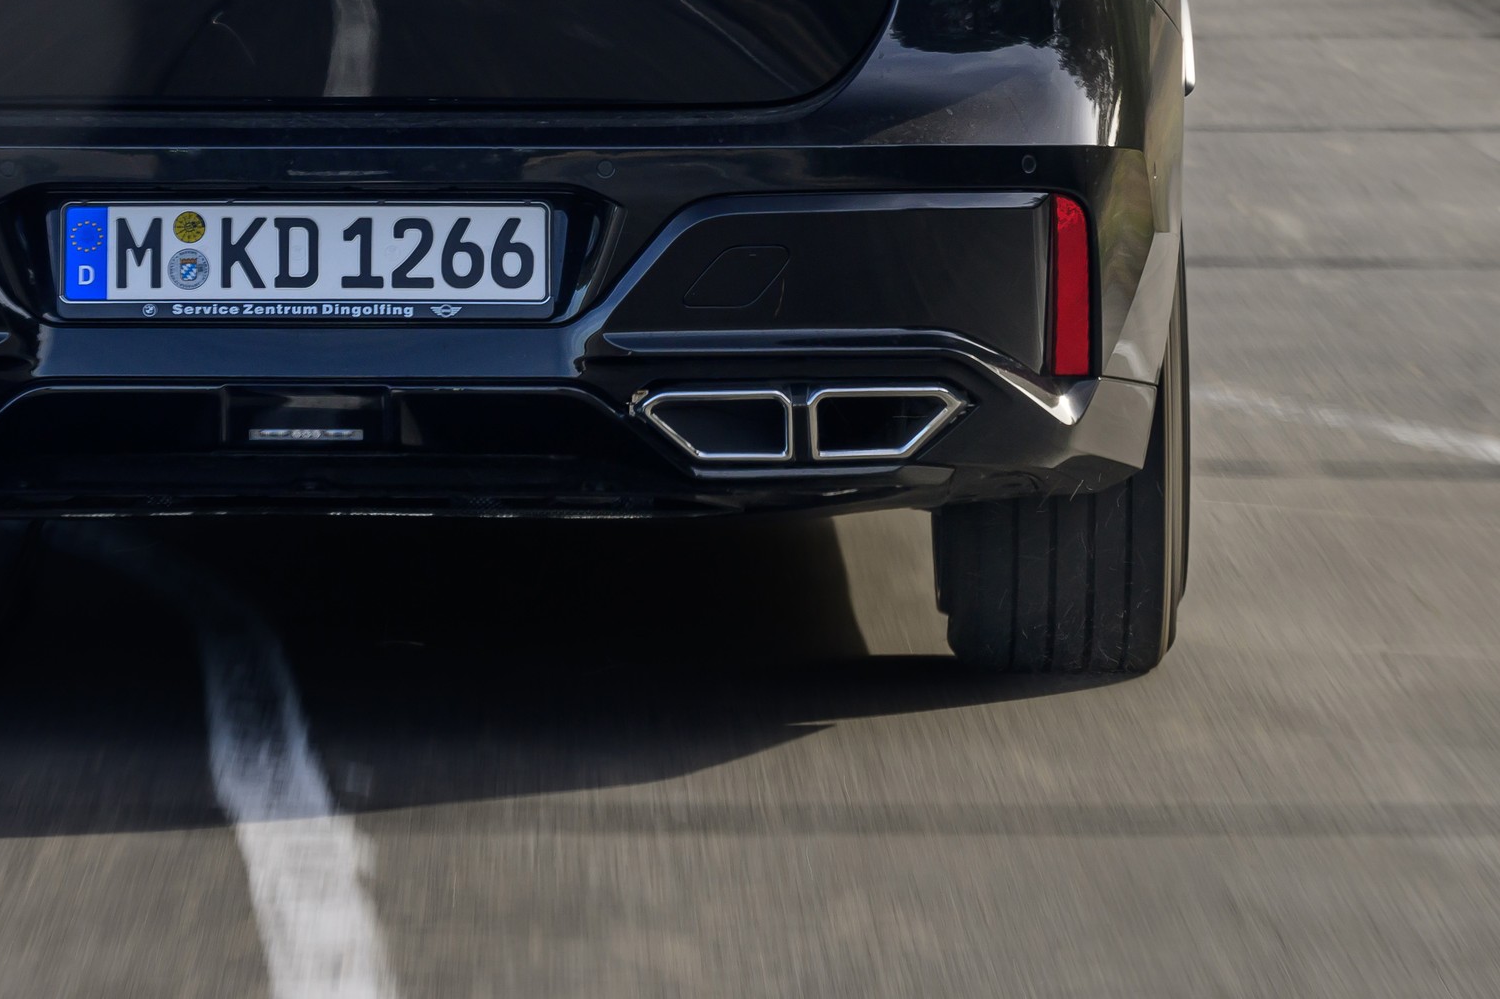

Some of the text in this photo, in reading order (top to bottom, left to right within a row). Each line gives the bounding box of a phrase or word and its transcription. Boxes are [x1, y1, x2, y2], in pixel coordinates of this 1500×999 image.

[115, 217, 162, 289] M
[220, 217, 319, 289] KD
[341, 217, 534, 289] 1266
[78, 265, 95, 286] D
[172, 303, 414, 318] Service Zentrum Dingolfing
